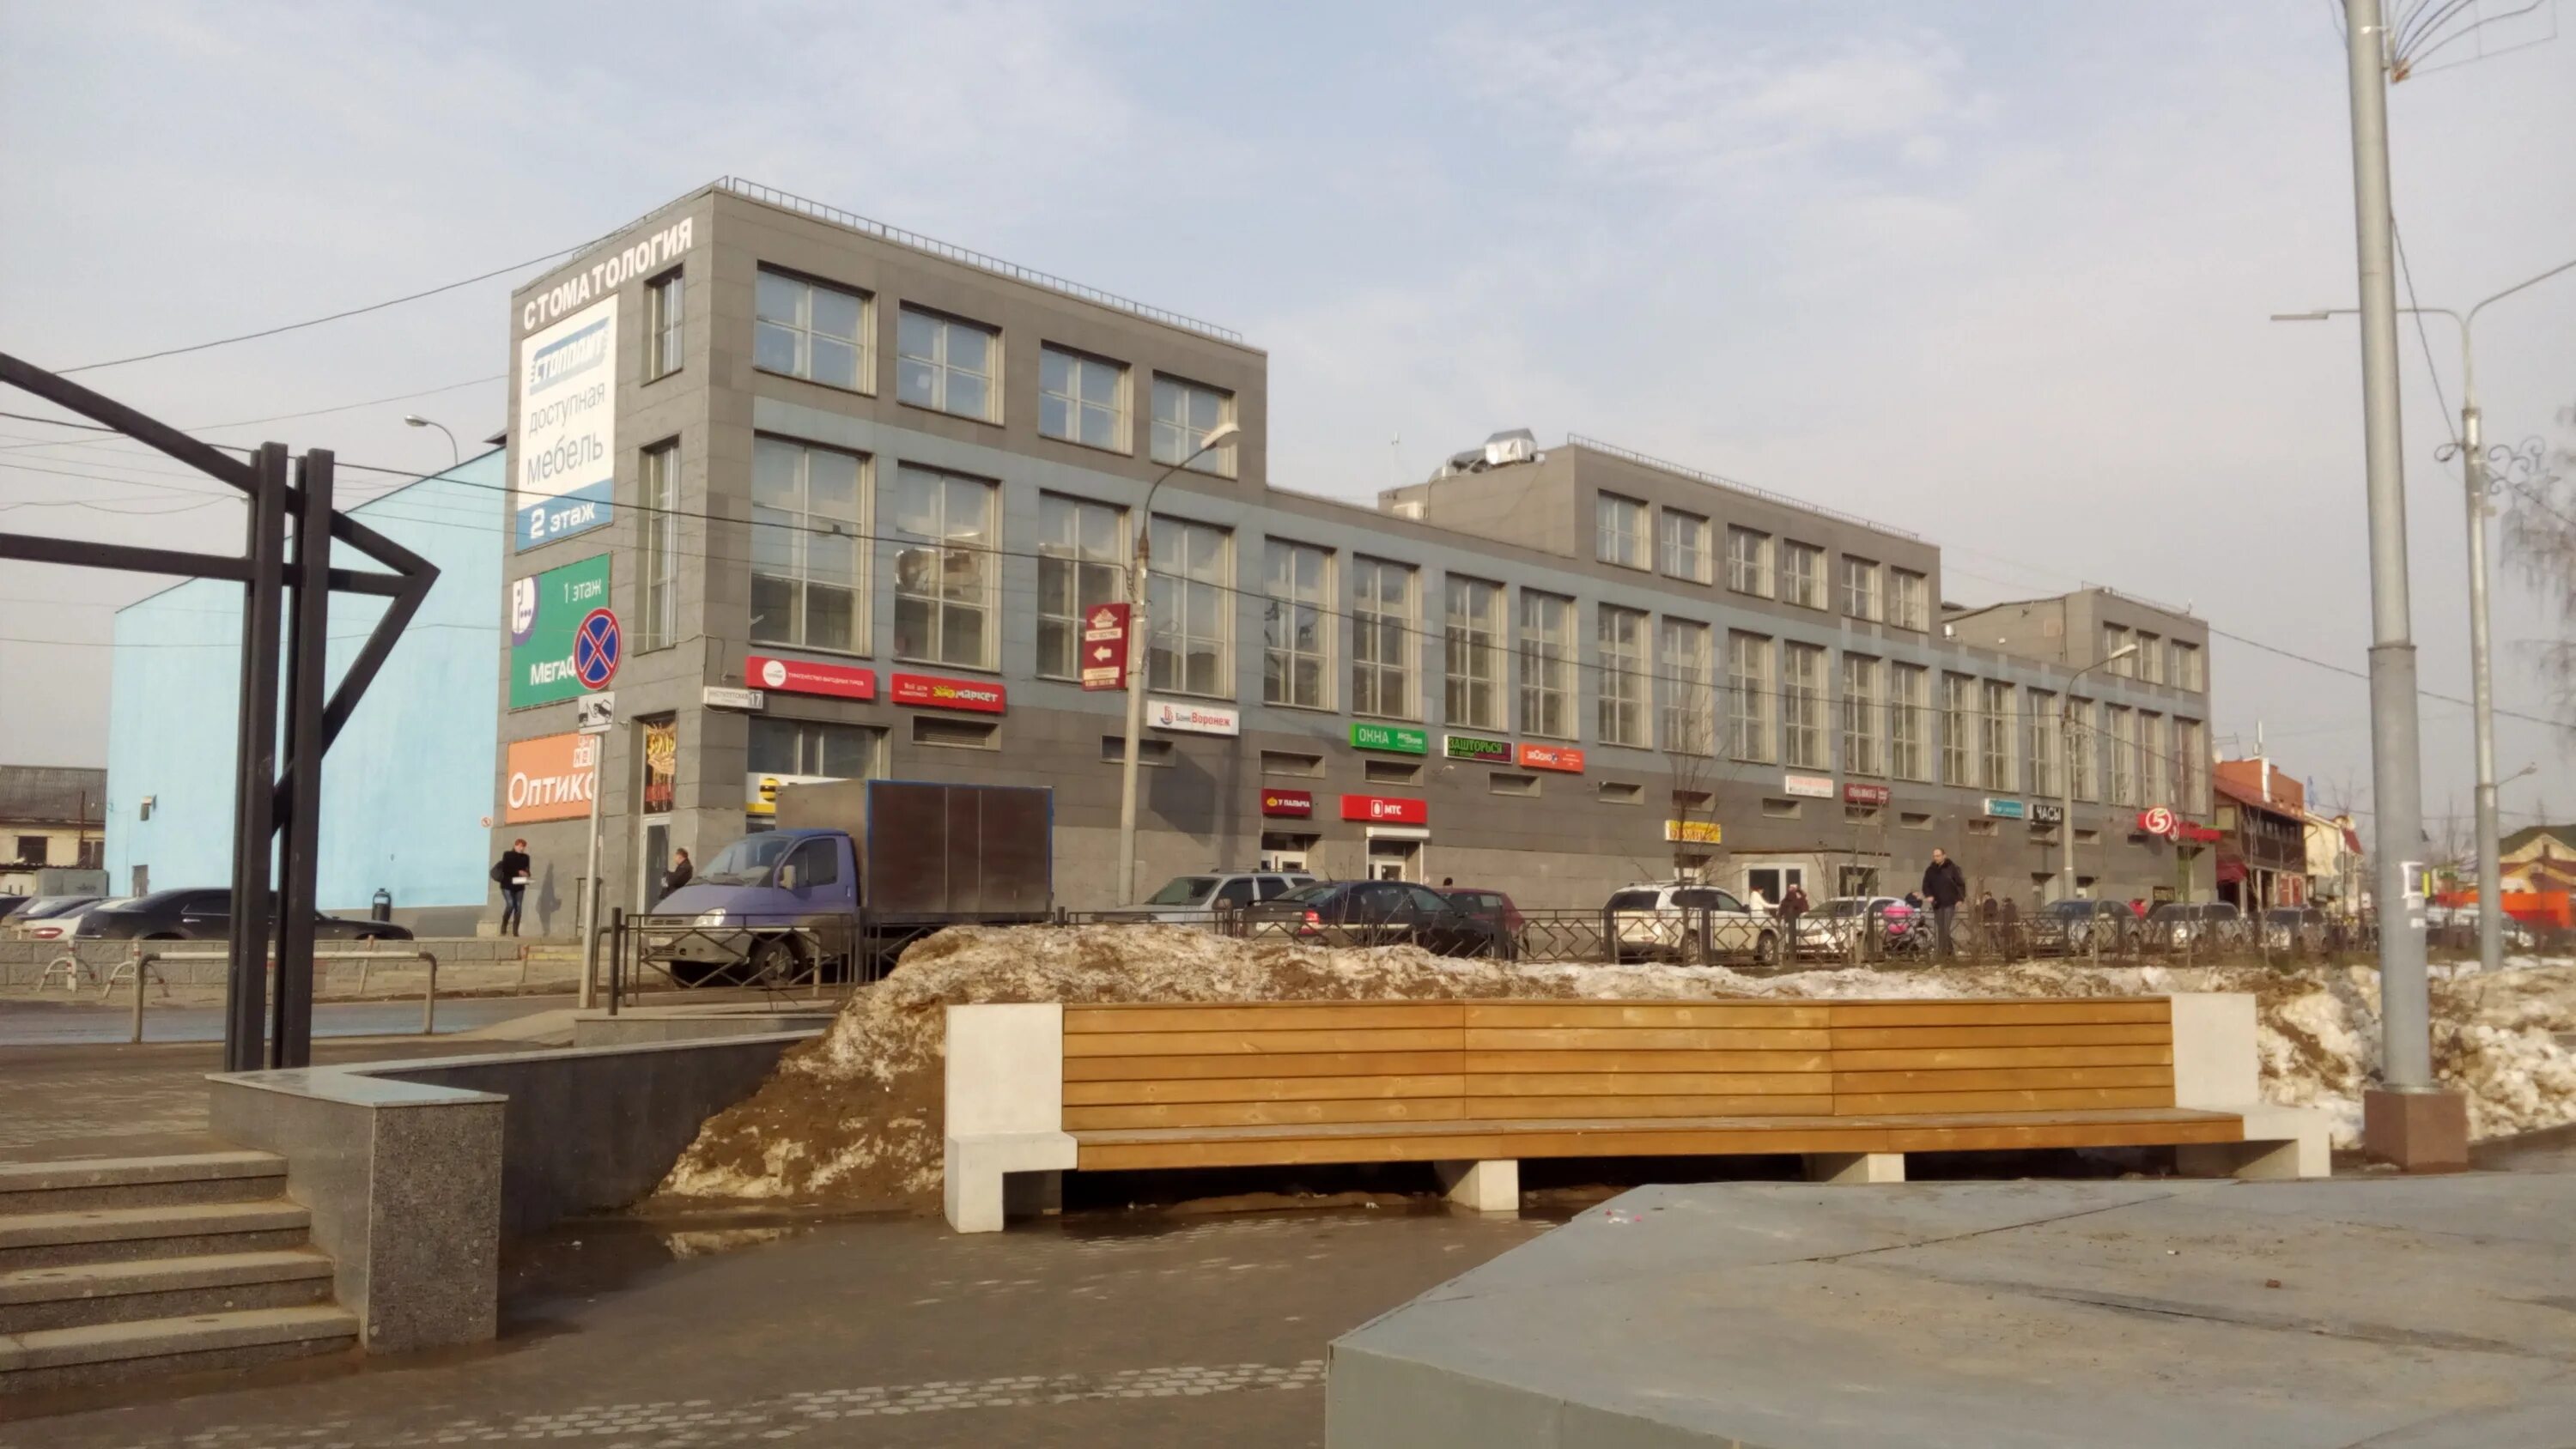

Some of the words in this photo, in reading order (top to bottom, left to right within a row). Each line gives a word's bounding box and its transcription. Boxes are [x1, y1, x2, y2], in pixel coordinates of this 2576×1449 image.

[523, 216, 693, 330] СТОМАТОЛОГИЯ
[529, 382, 605, 439] доступная
[526, 432, 604, 486] мебель
[530, 507, 545, 539] 2
[550, 501, 596, 533] этаж
[563, 582, 569, 603] 1
[573, 578, 602, 603] этаж
[750, 691, 762, 706] 17
[1191, 712, 1230, 727] Воронеж
[1358, 728, 1389, 744] ОКНА
[1449, 737, 1503, 755] ЗАШТОРЬСЯ
[1384, 804, 1402, 815] МТС
[2036, 804, 2061, 822] ЧАСЫ
